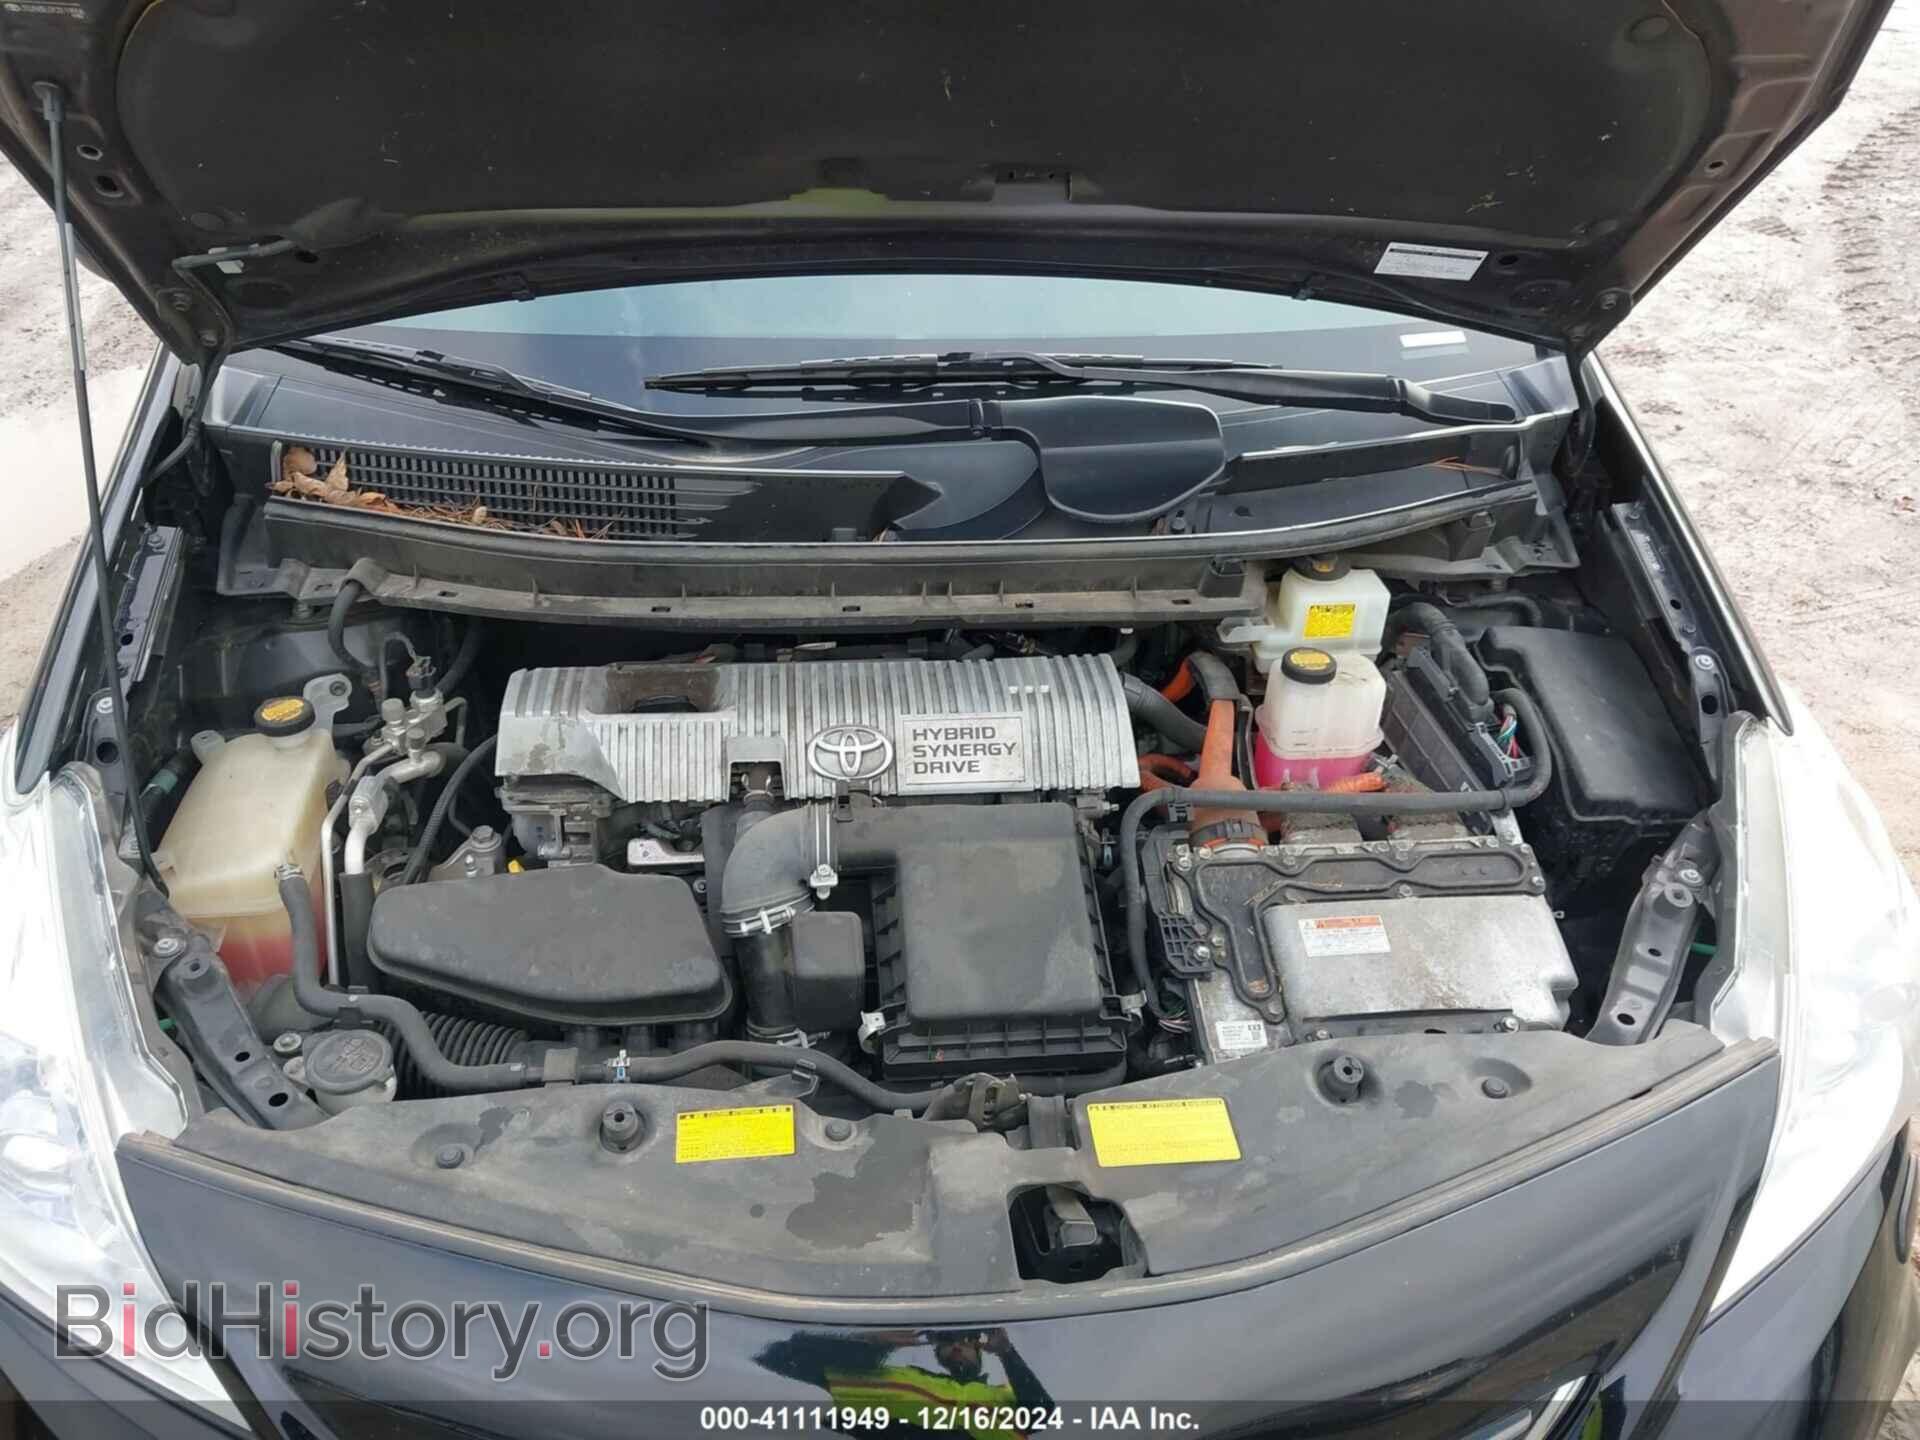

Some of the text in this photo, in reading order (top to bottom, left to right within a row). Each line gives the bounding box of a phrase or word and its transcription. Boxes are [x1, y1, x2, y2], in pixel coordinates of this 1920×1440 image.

[912, 726, 996, 741] HYBRID
[913, 742, 1017, 758] SYNERGY
[914, 760, 980, 774] DRIVE
